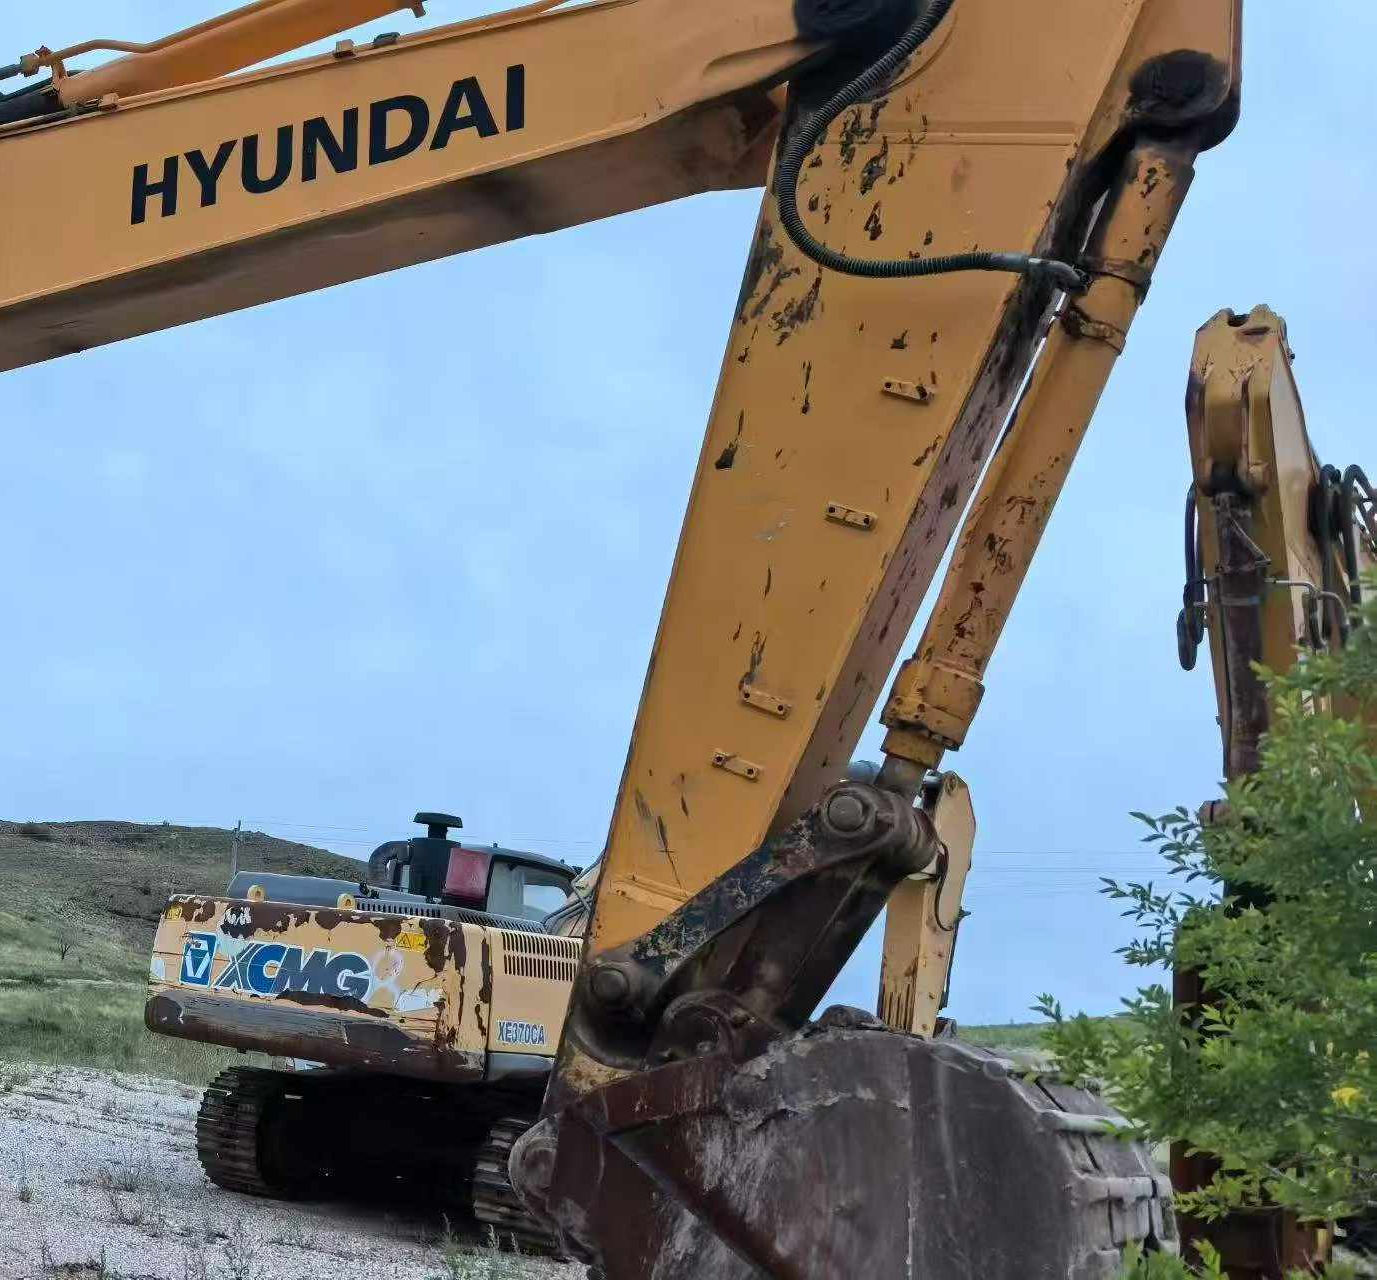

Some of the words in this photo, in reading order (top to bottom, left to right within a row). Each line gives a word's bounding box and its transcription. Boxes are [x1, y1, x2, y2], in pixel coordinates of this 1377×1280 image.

[130, 63, 525, 225] HYUNDAI
[211, 942, 371, 1001] XCMG
[497, 1020, 545, 1045] XE370CA
